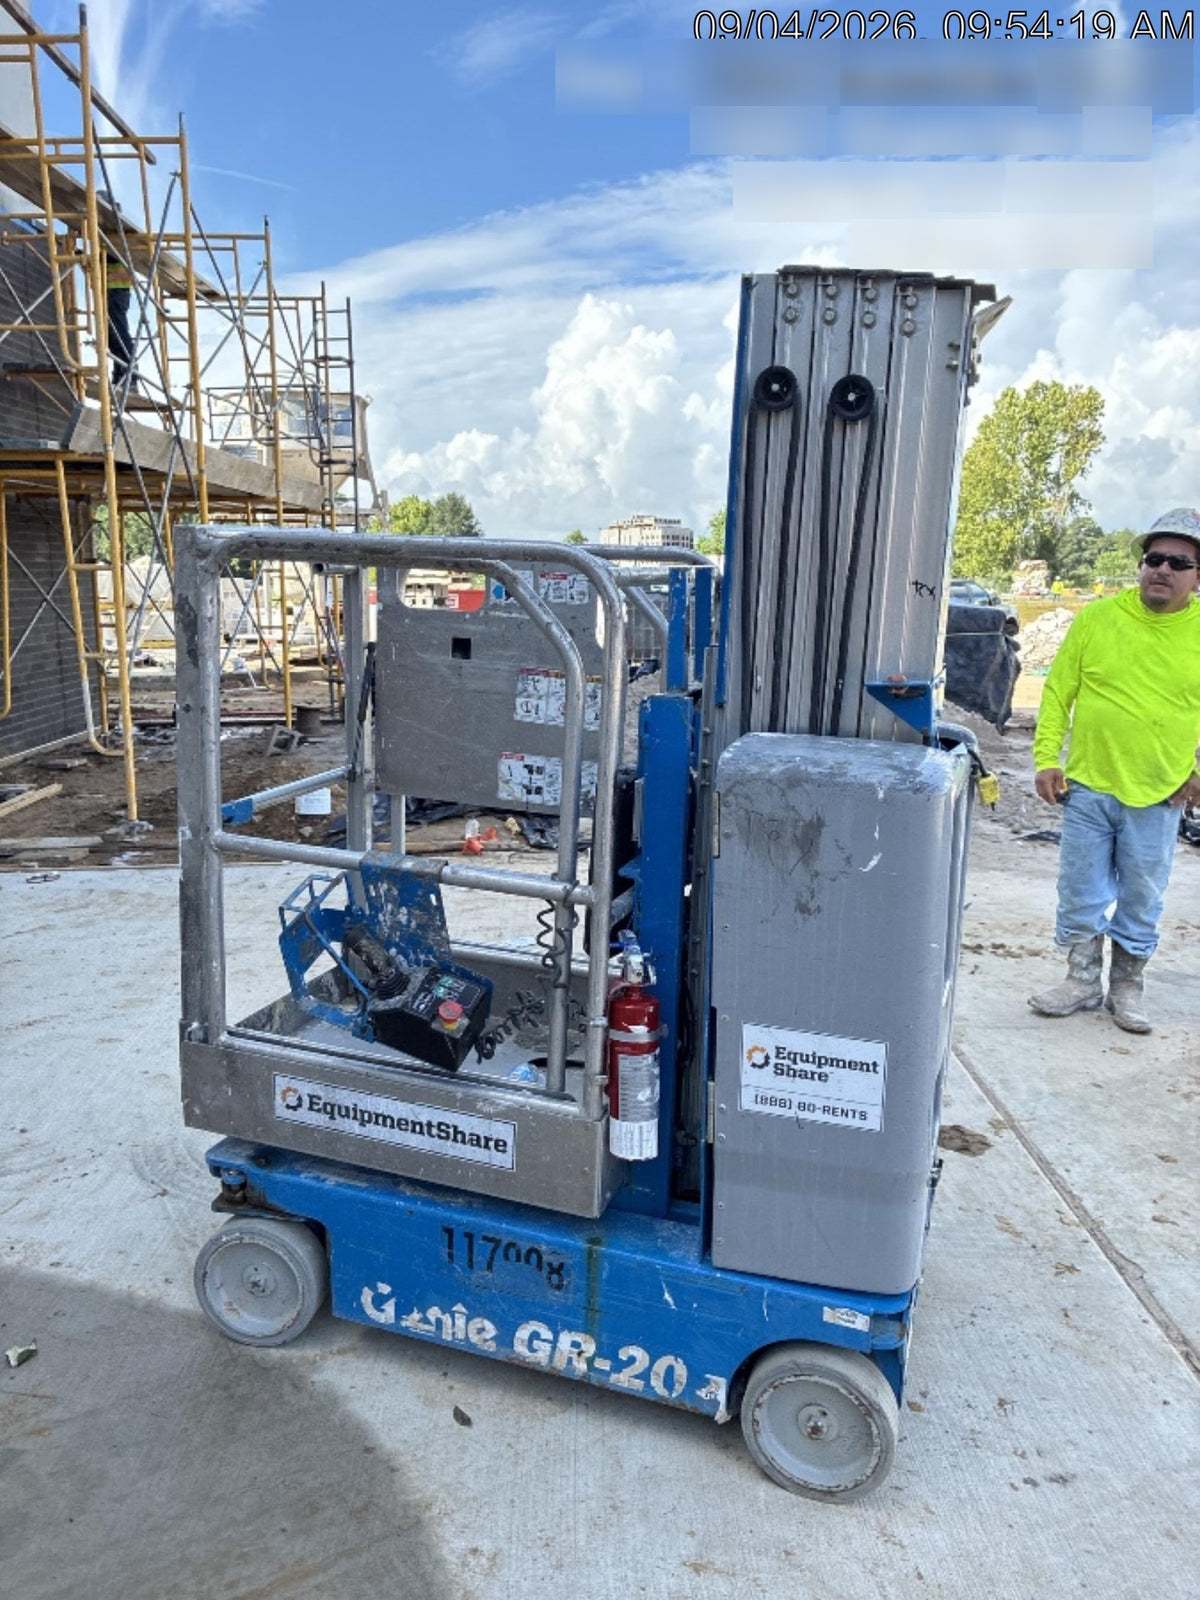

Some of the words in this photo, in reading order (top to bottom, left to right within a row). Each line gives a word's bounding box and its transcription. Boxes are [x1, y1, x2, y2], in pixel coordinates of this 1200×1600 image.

[773, 1063, 829, 1082] Share
[774, 1046, 879, 1074] Equipment
[755, 1094, 792, 1110] (888)
[798, 1102, 868, 1121] 80-RENTS
[306, 1093, 509, 1153] EquipmentShare
[513, 1320, 689, 1399] GR-20
